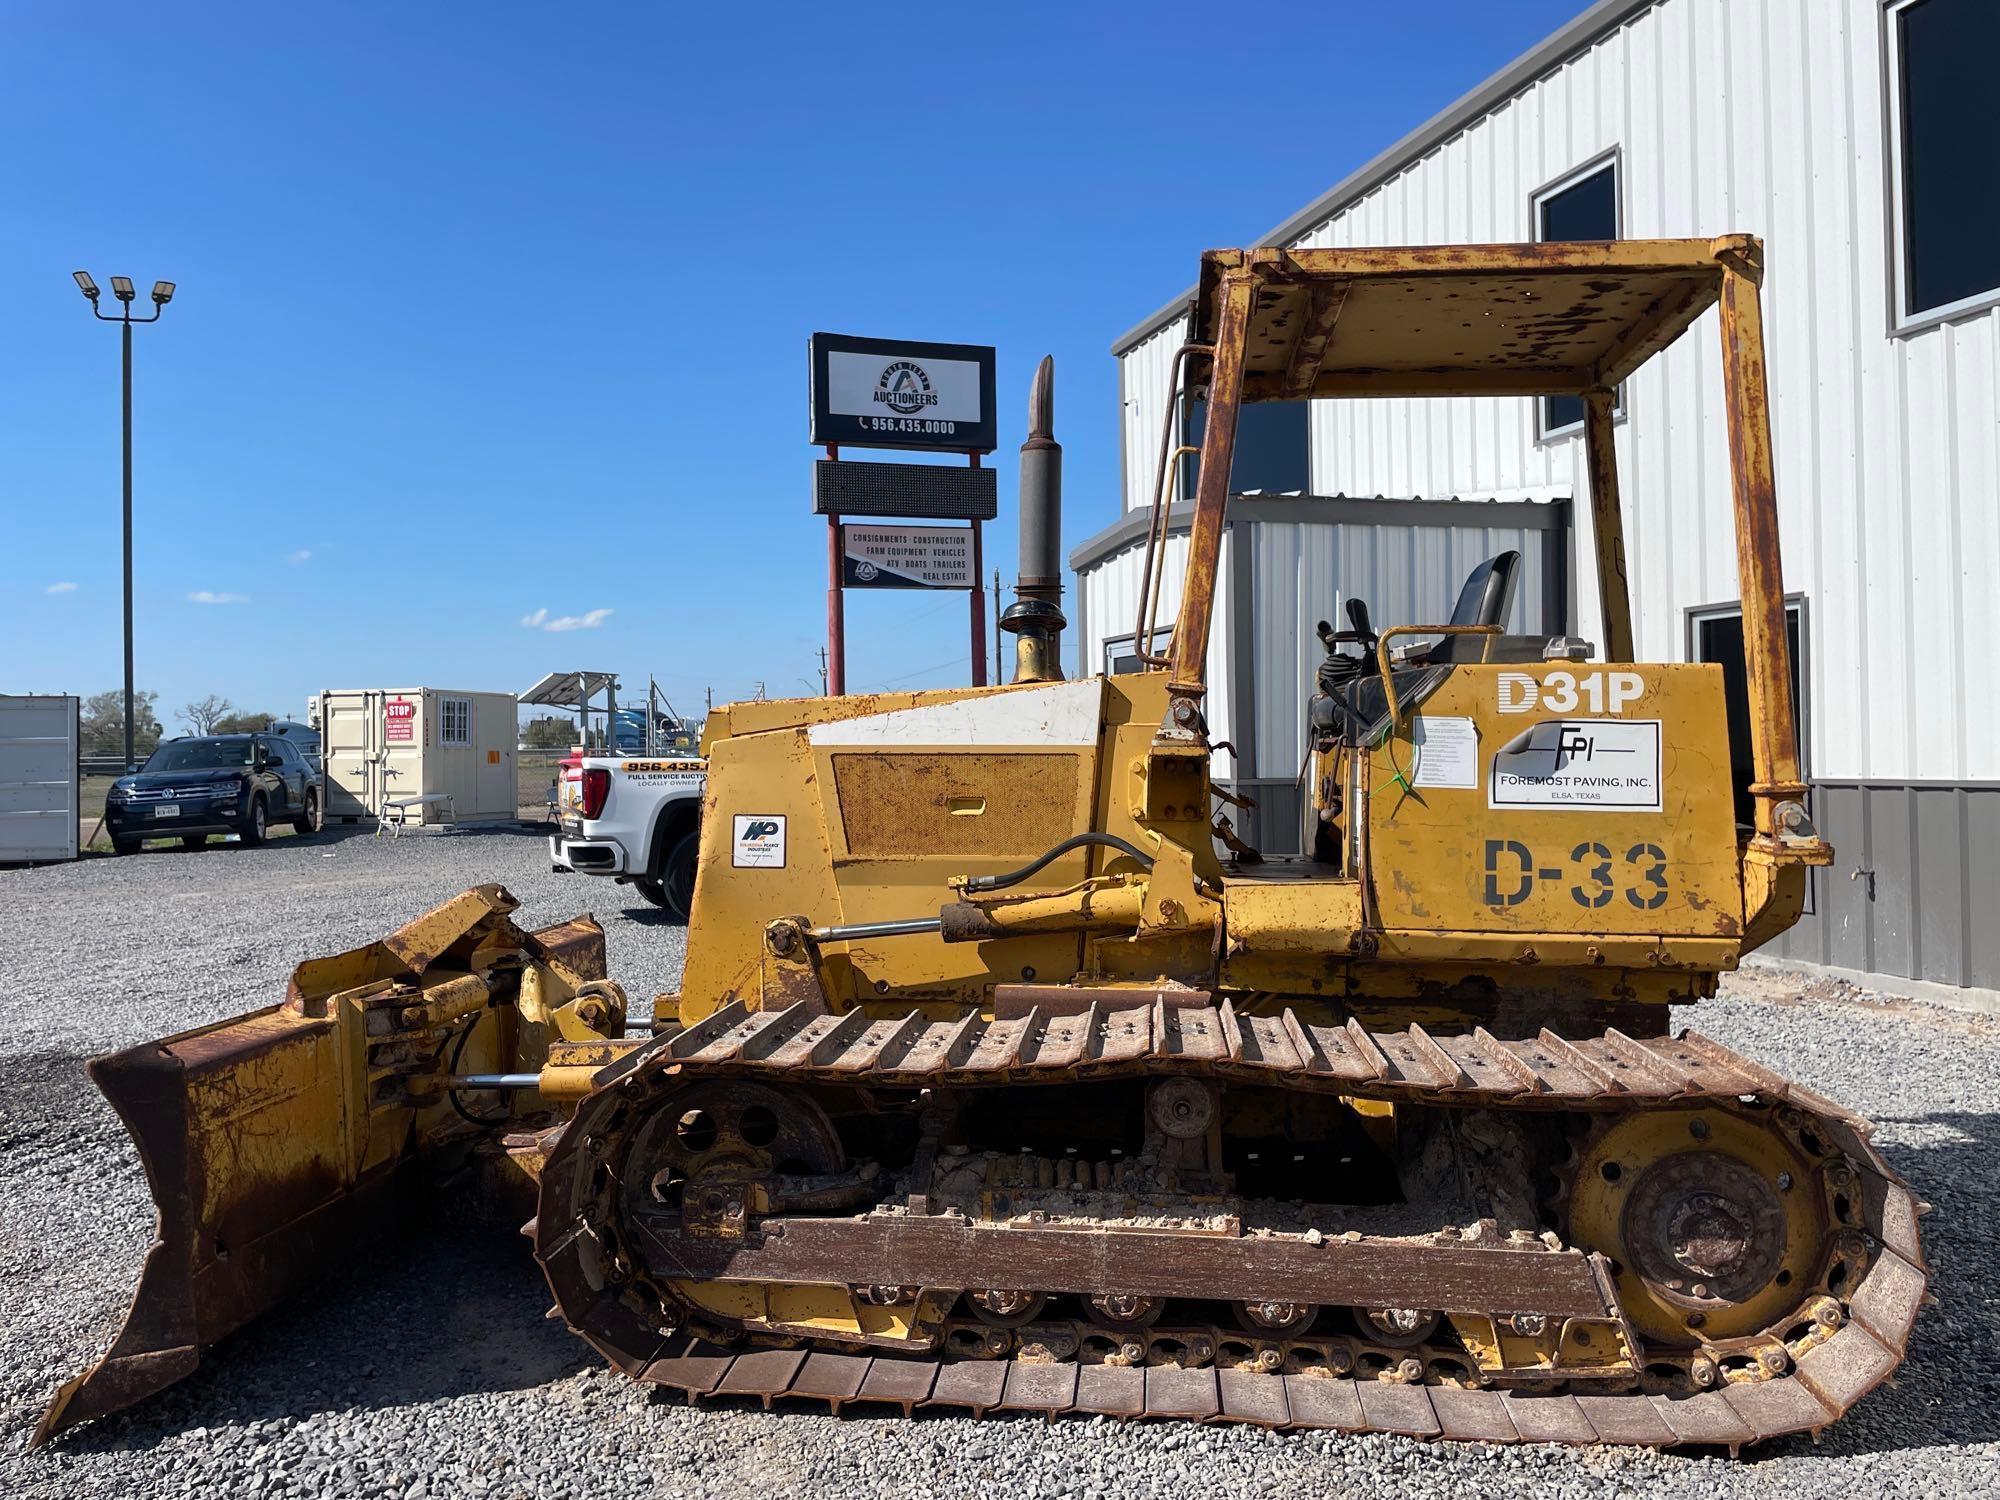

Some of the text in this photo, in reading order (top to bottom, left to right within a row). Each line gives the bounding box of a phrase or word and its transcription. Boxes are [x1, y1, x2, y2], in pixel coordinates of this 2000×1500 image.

[881, 362, 930, 390] SOUTH TEXAS
[873, 391, 938, 406] AUCTIONEERS
[872, 417, 955, 434] 956.435.0000
[853, 533, 966, 545] CONSIGNMENTS CONSTRUCTION
[866, 546, 966, 557] FARM EQUIPMENT VEHICLES
[886, 559, 966, 569] ATV BOATS TRAILERS
[923, 572, 966, 581] REAL ESTATE
[1497, 671, 1645, 714] D31P
[389, 705, 410, 716] STOP
[1500, 775, 1652, 789] FOREMOST PAVING, INC.
[1551, 792, 1601, 801] ELSA, TEXAS
[1484, 839, 1669, 910] D-33
